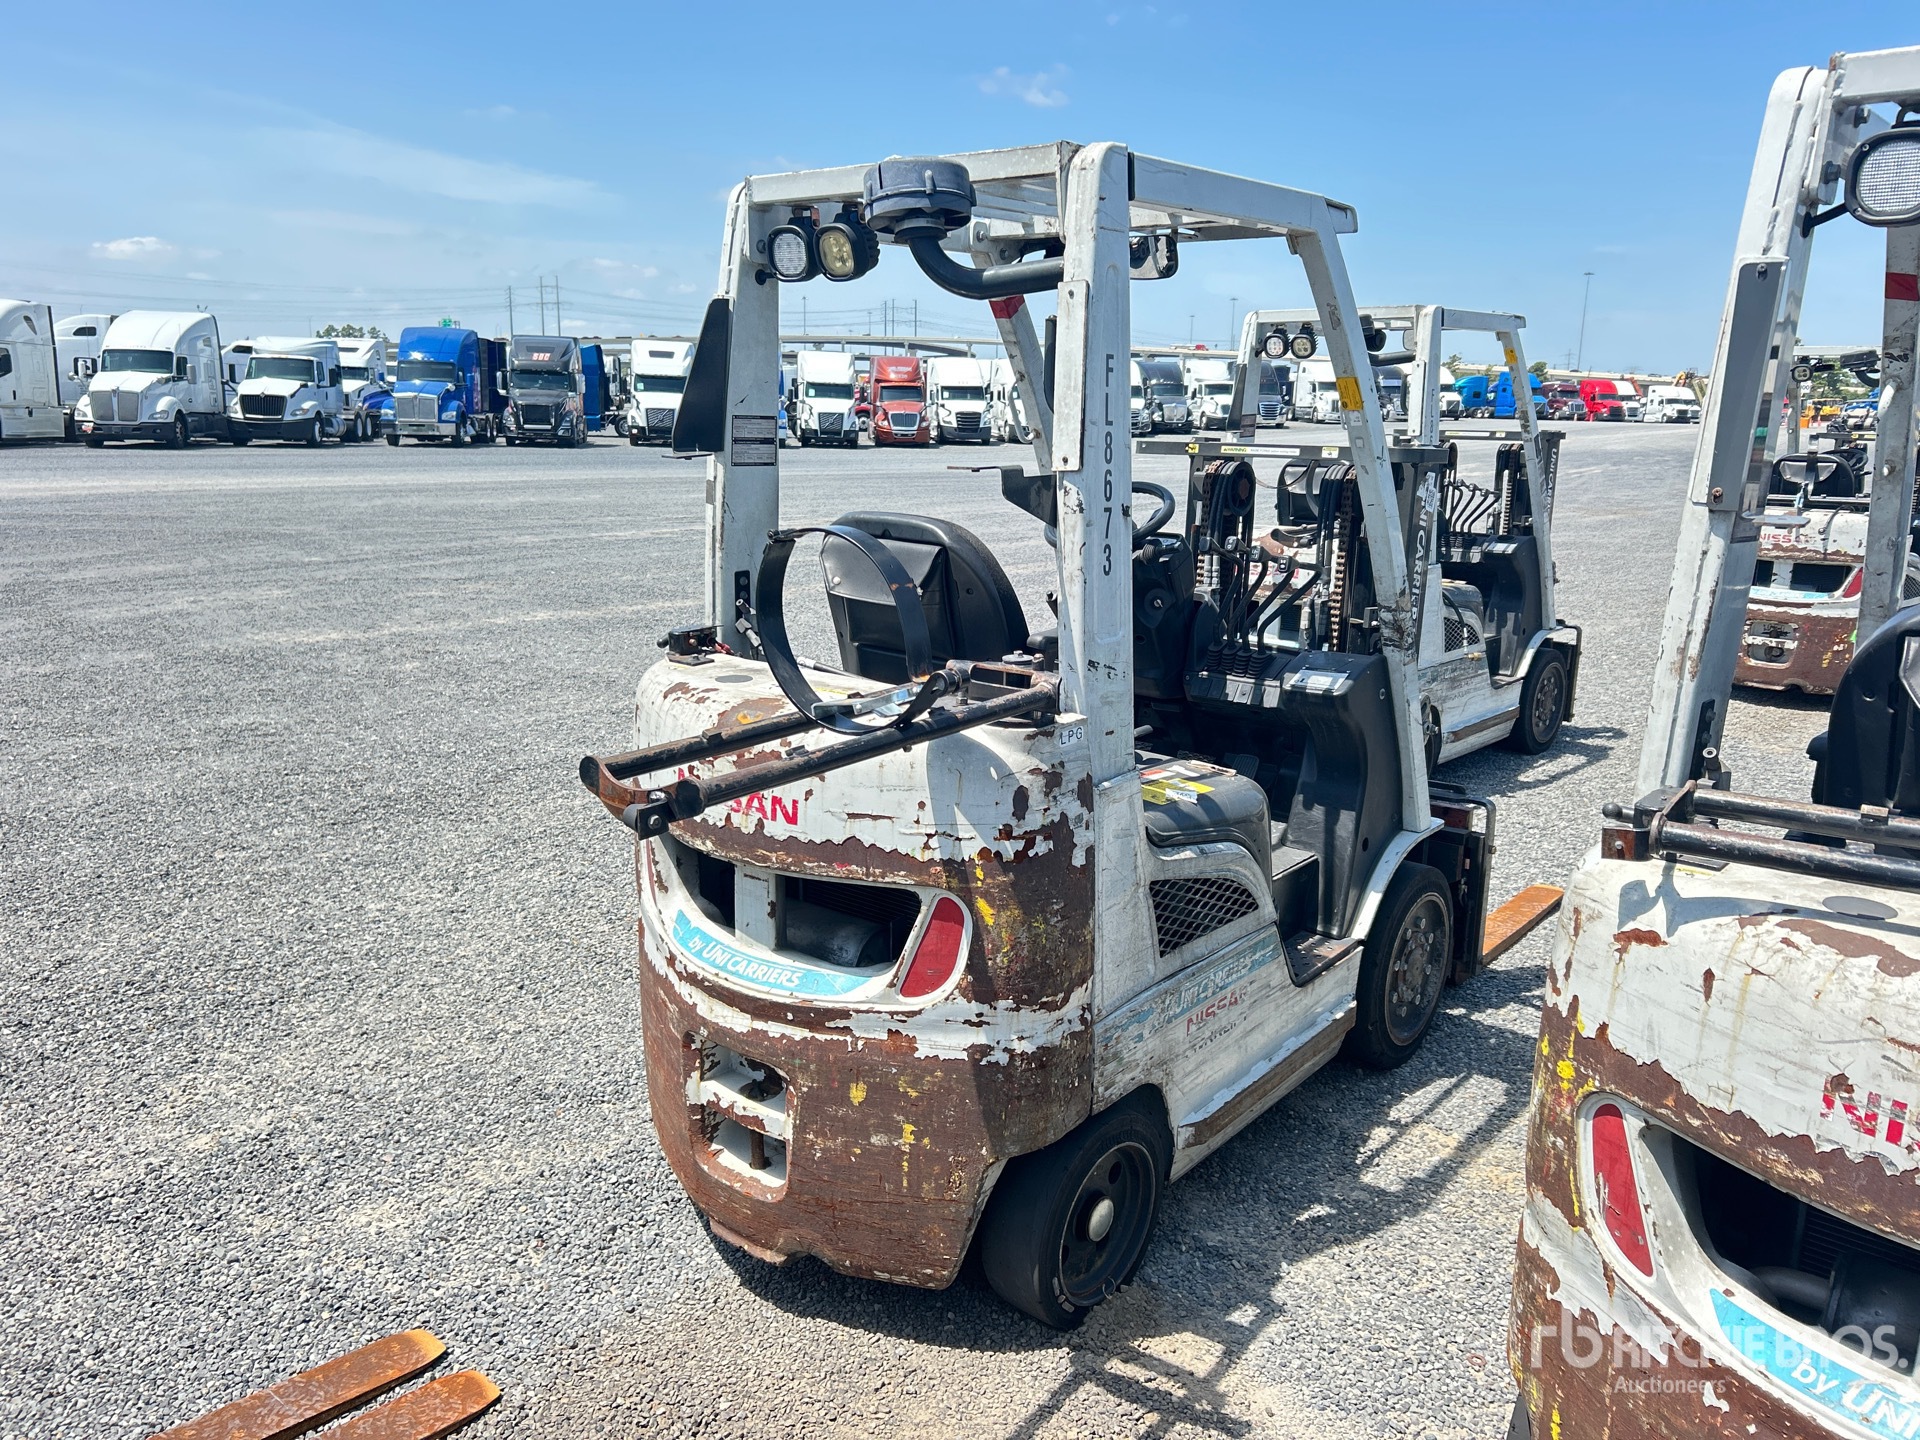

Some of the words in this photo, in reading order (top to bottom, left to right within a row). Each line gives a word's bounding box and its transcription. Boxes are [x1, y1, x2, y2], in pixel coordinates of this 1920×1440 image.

[1102, 353, 1115, 577] FL8673
[1059, 726, 1083, 746] LPG
[689, 937, 707, 954] by
[1791, 1358, 1840, 1395] by
